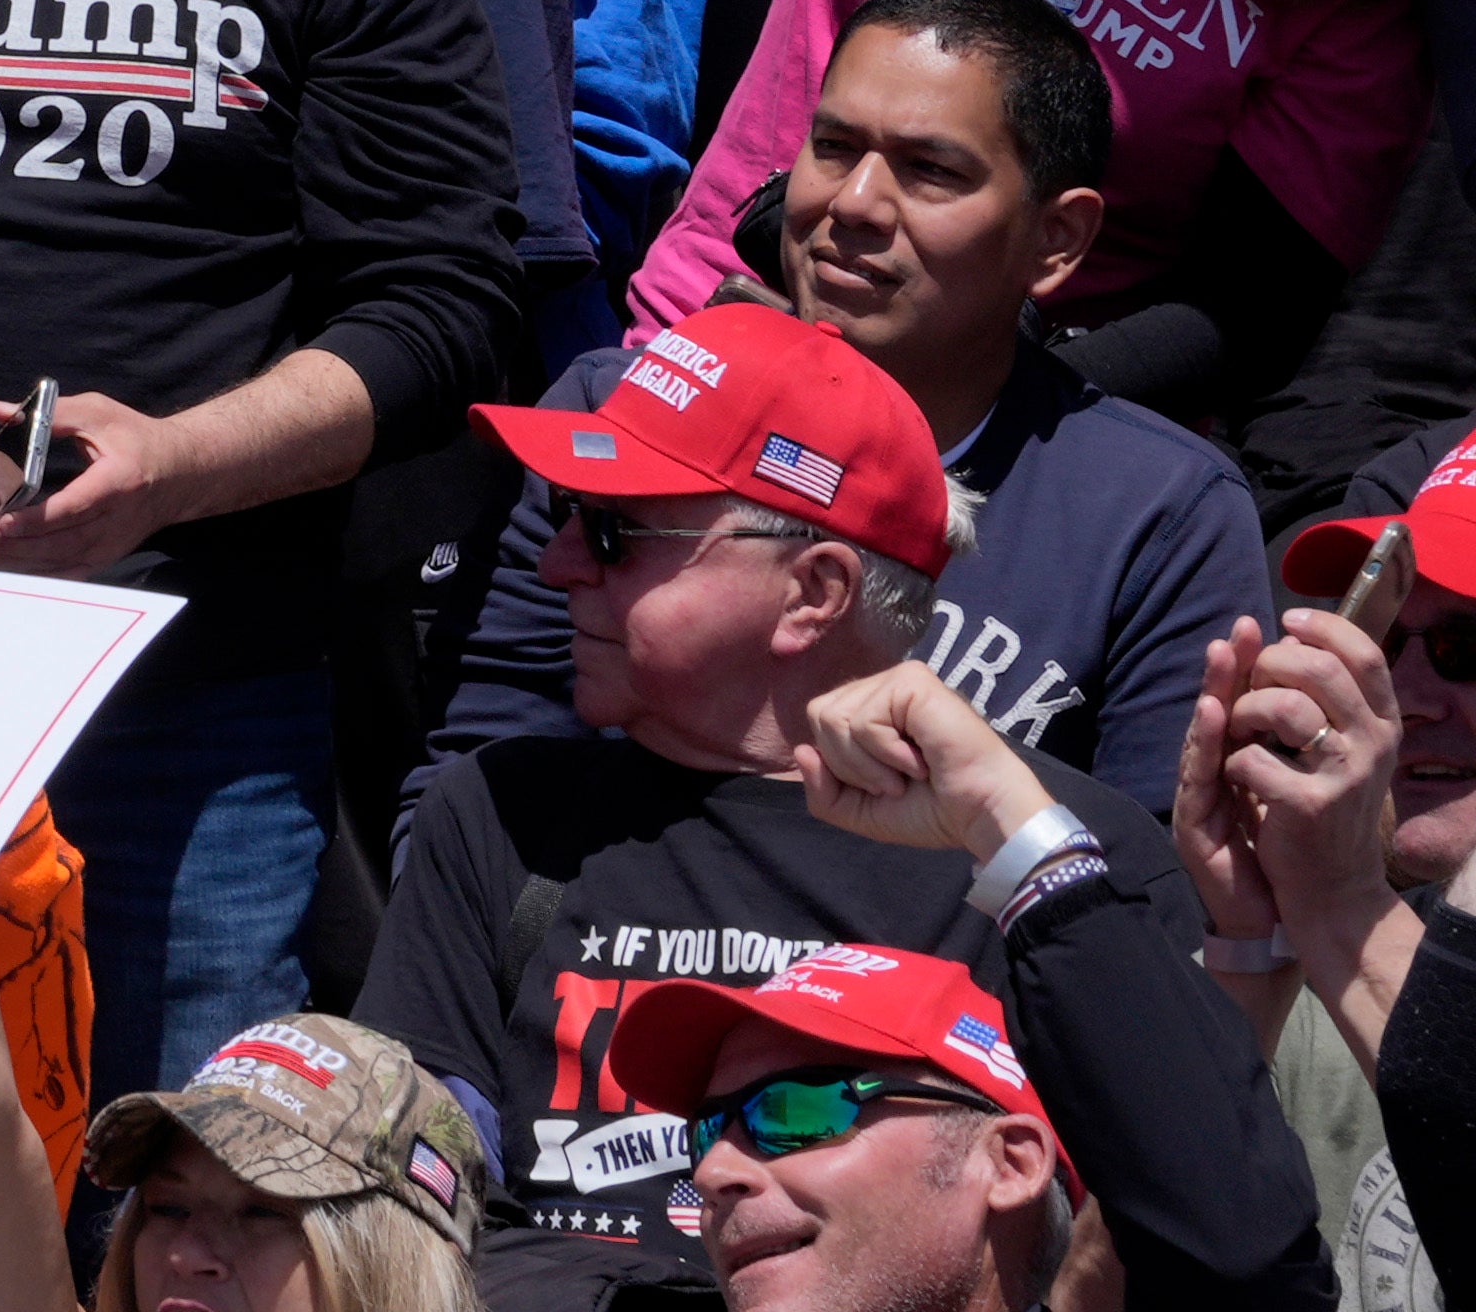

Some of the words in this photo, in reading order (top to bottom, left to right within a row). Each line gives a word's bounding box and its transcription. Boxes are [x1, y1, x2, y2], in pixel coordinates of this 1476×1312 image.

[628, 360, 701, 412] AGAIN
[612, 926, 652, 967] IF
[657, 928, 716, 976] YOU
[259, 1083, 307, 1116] BACK
[593, 1128, 657, 1176] THEN
